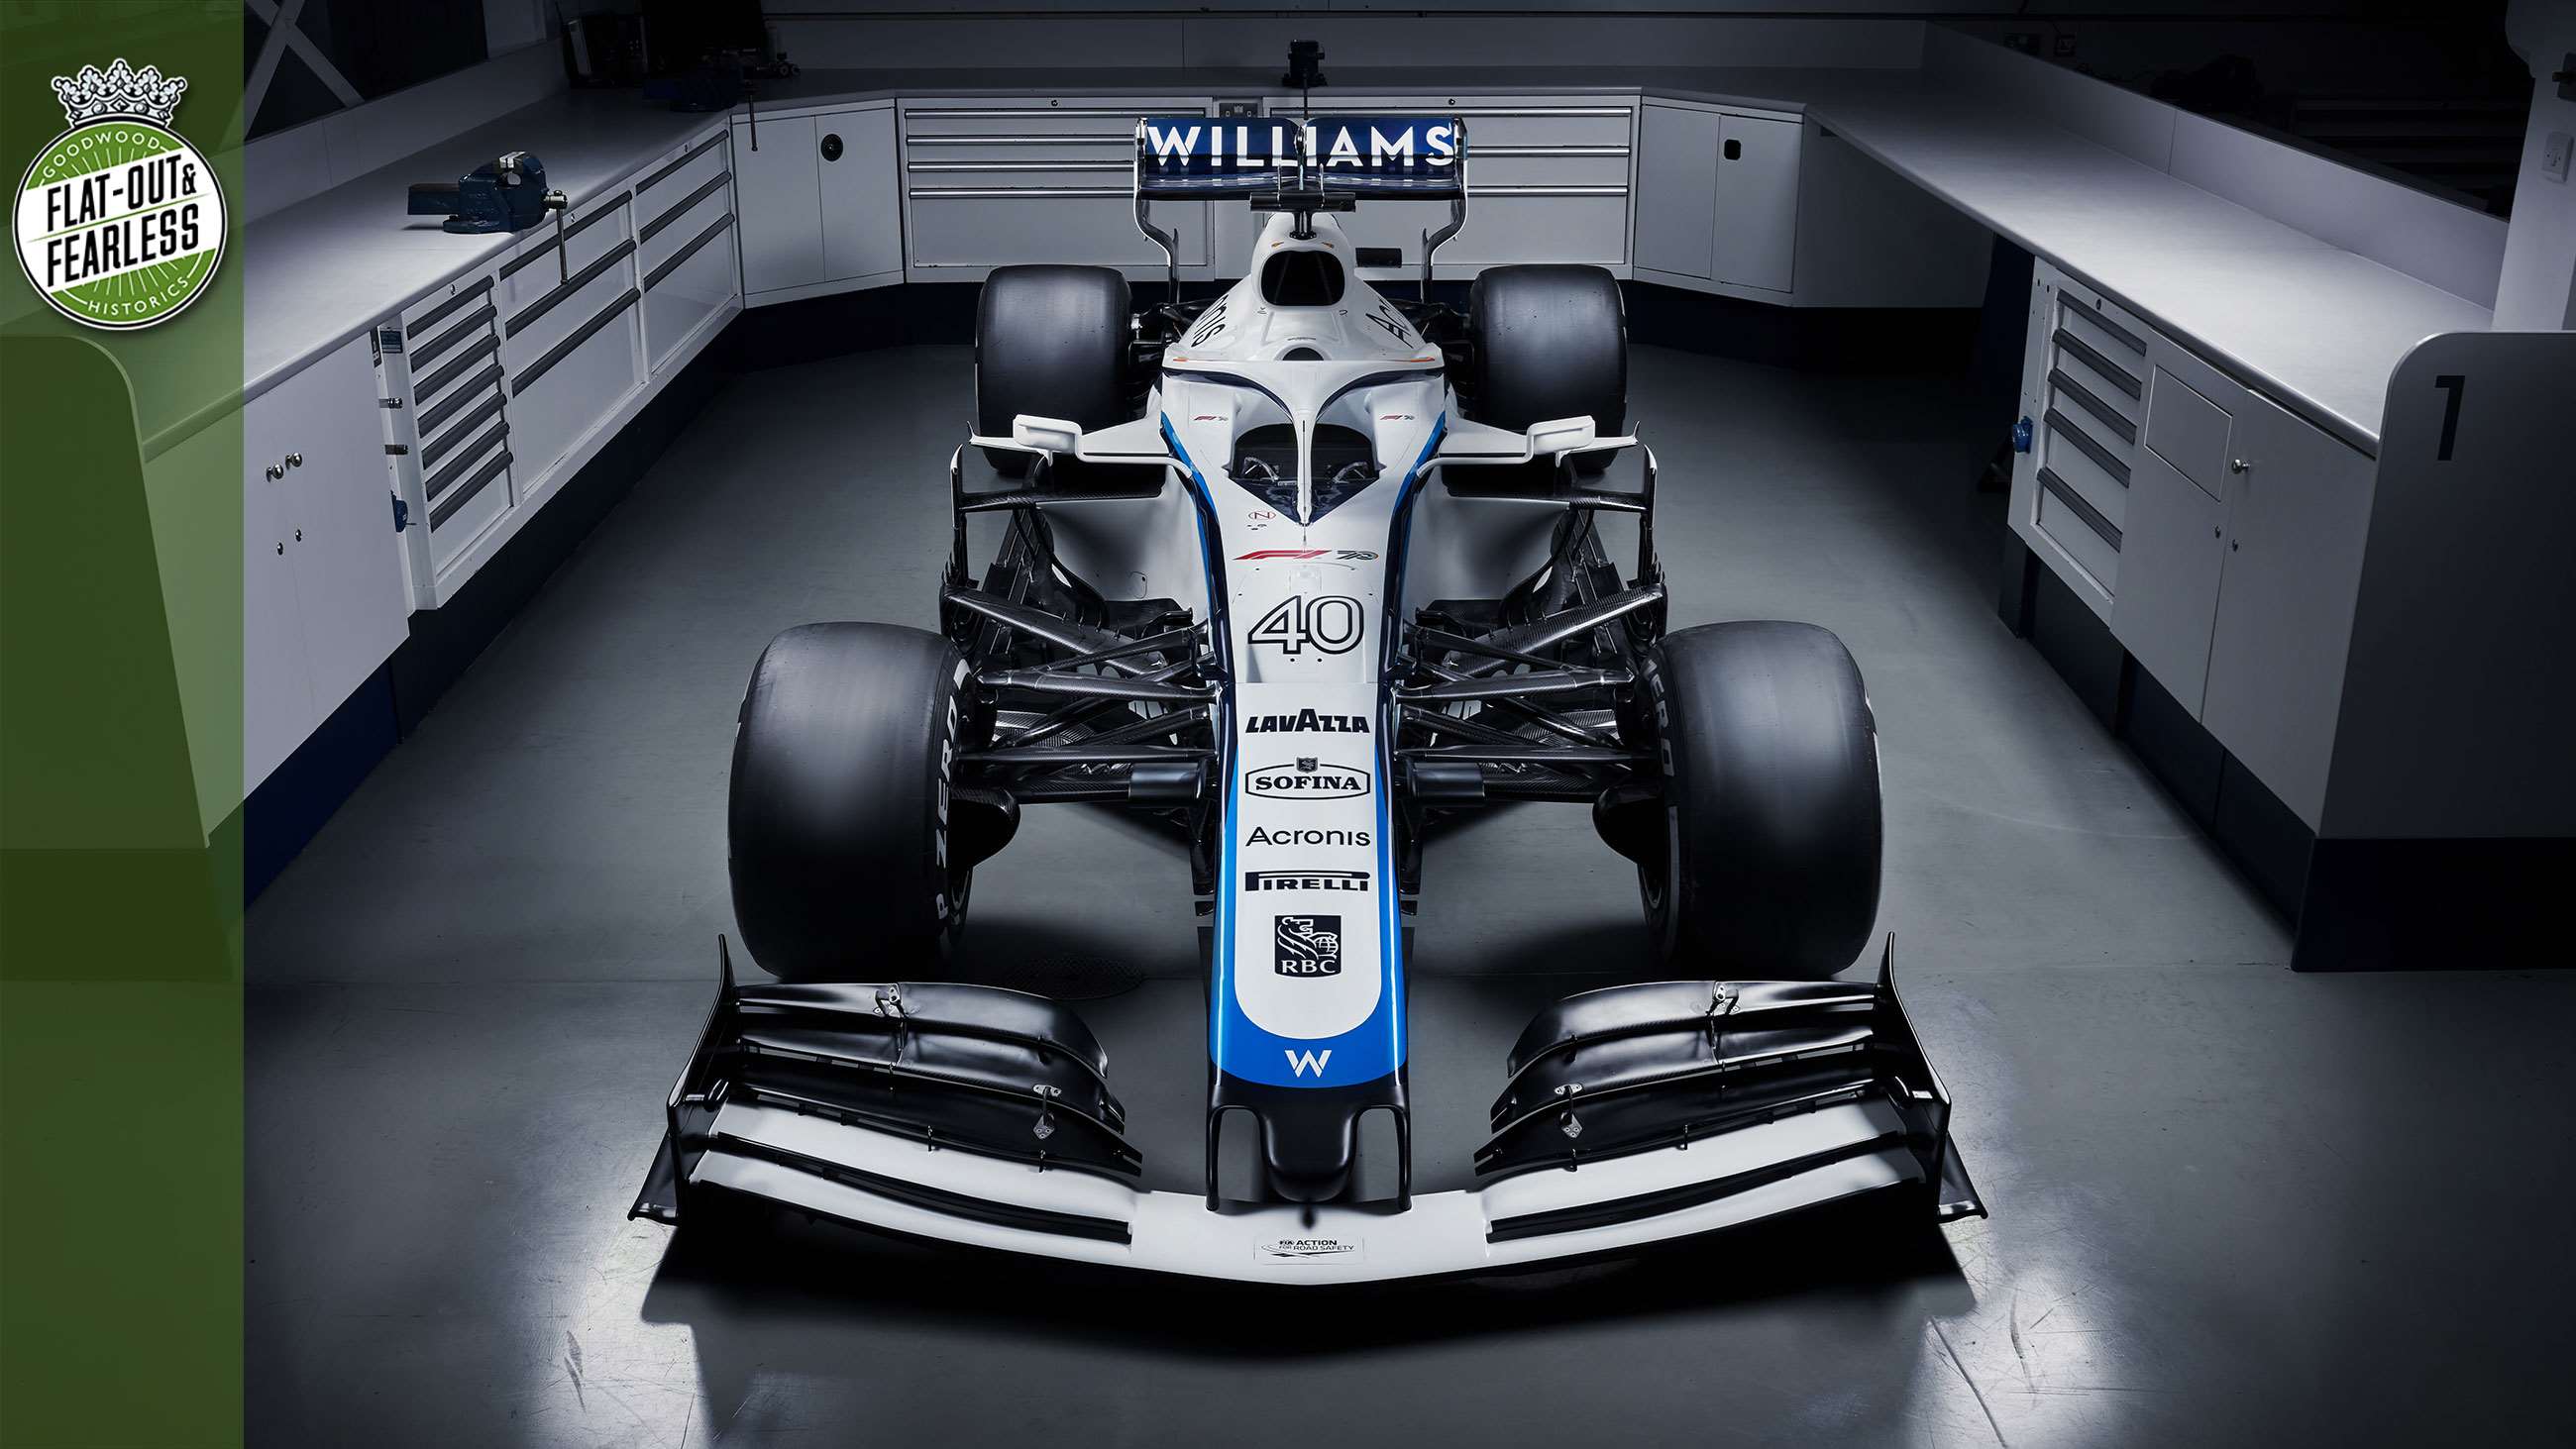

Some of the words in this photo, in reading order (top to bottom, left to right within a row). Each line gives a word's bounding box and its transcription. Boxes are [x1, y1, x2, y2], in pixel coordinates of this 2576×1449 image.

[1146, 126, 1454, 167] WILLIAMS
[2434, 374, 2466, 462] 1
[1247, 594, 1364, 655] 40
[1244, 708, 1371, 734] LAVAZZA
[936, 694, 958, 870] ZERO
[1254, 776, 1362, 791] SOFINA
[1244, 826, 1371, 847] Acronis
[1244, 870, 1371, 891] PIRELLI
[1280, 959, 1338, 974] RBC
[1284, 1049, 1333, 1078] W
